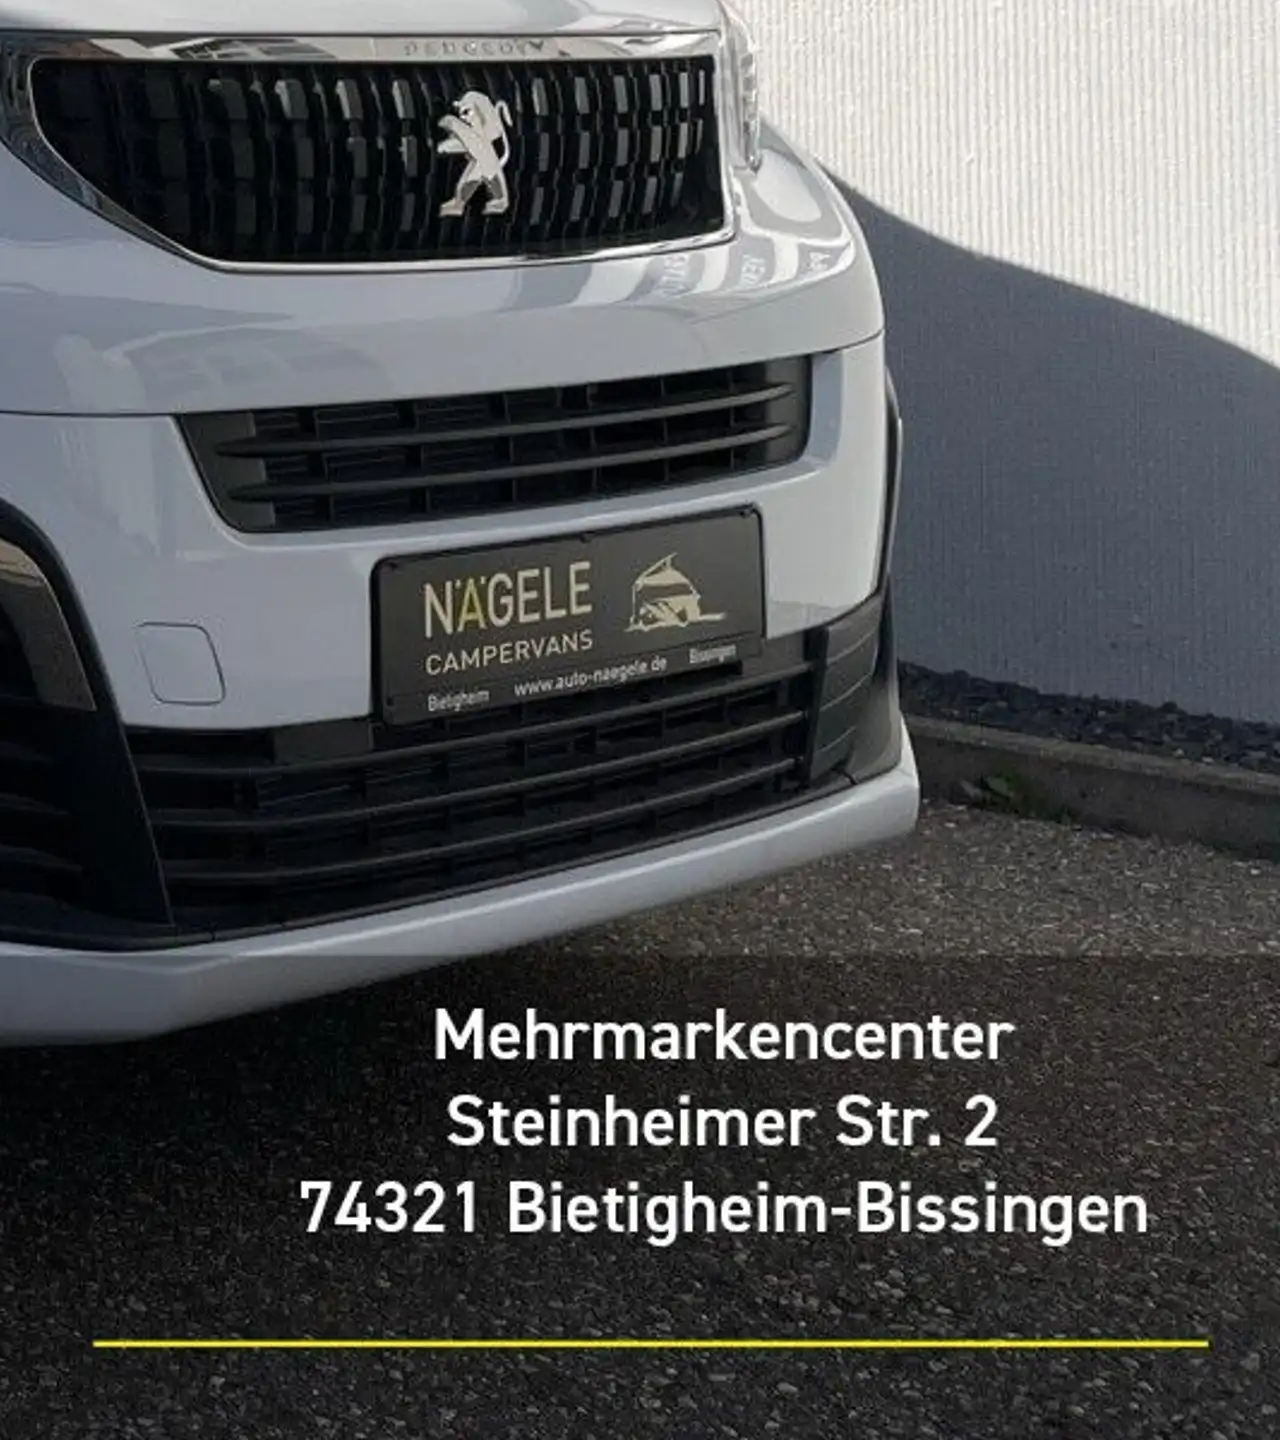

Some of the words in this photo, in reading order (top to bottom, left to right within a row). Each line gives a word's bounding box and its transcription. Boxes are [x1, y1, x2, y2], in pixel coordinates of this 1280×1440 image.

[424, 561, 593, 638] NÄGELE
[425, 629, 593, 676] CAMPERVANS
[514, 655, 668, 697] www.auto-naegele.de
